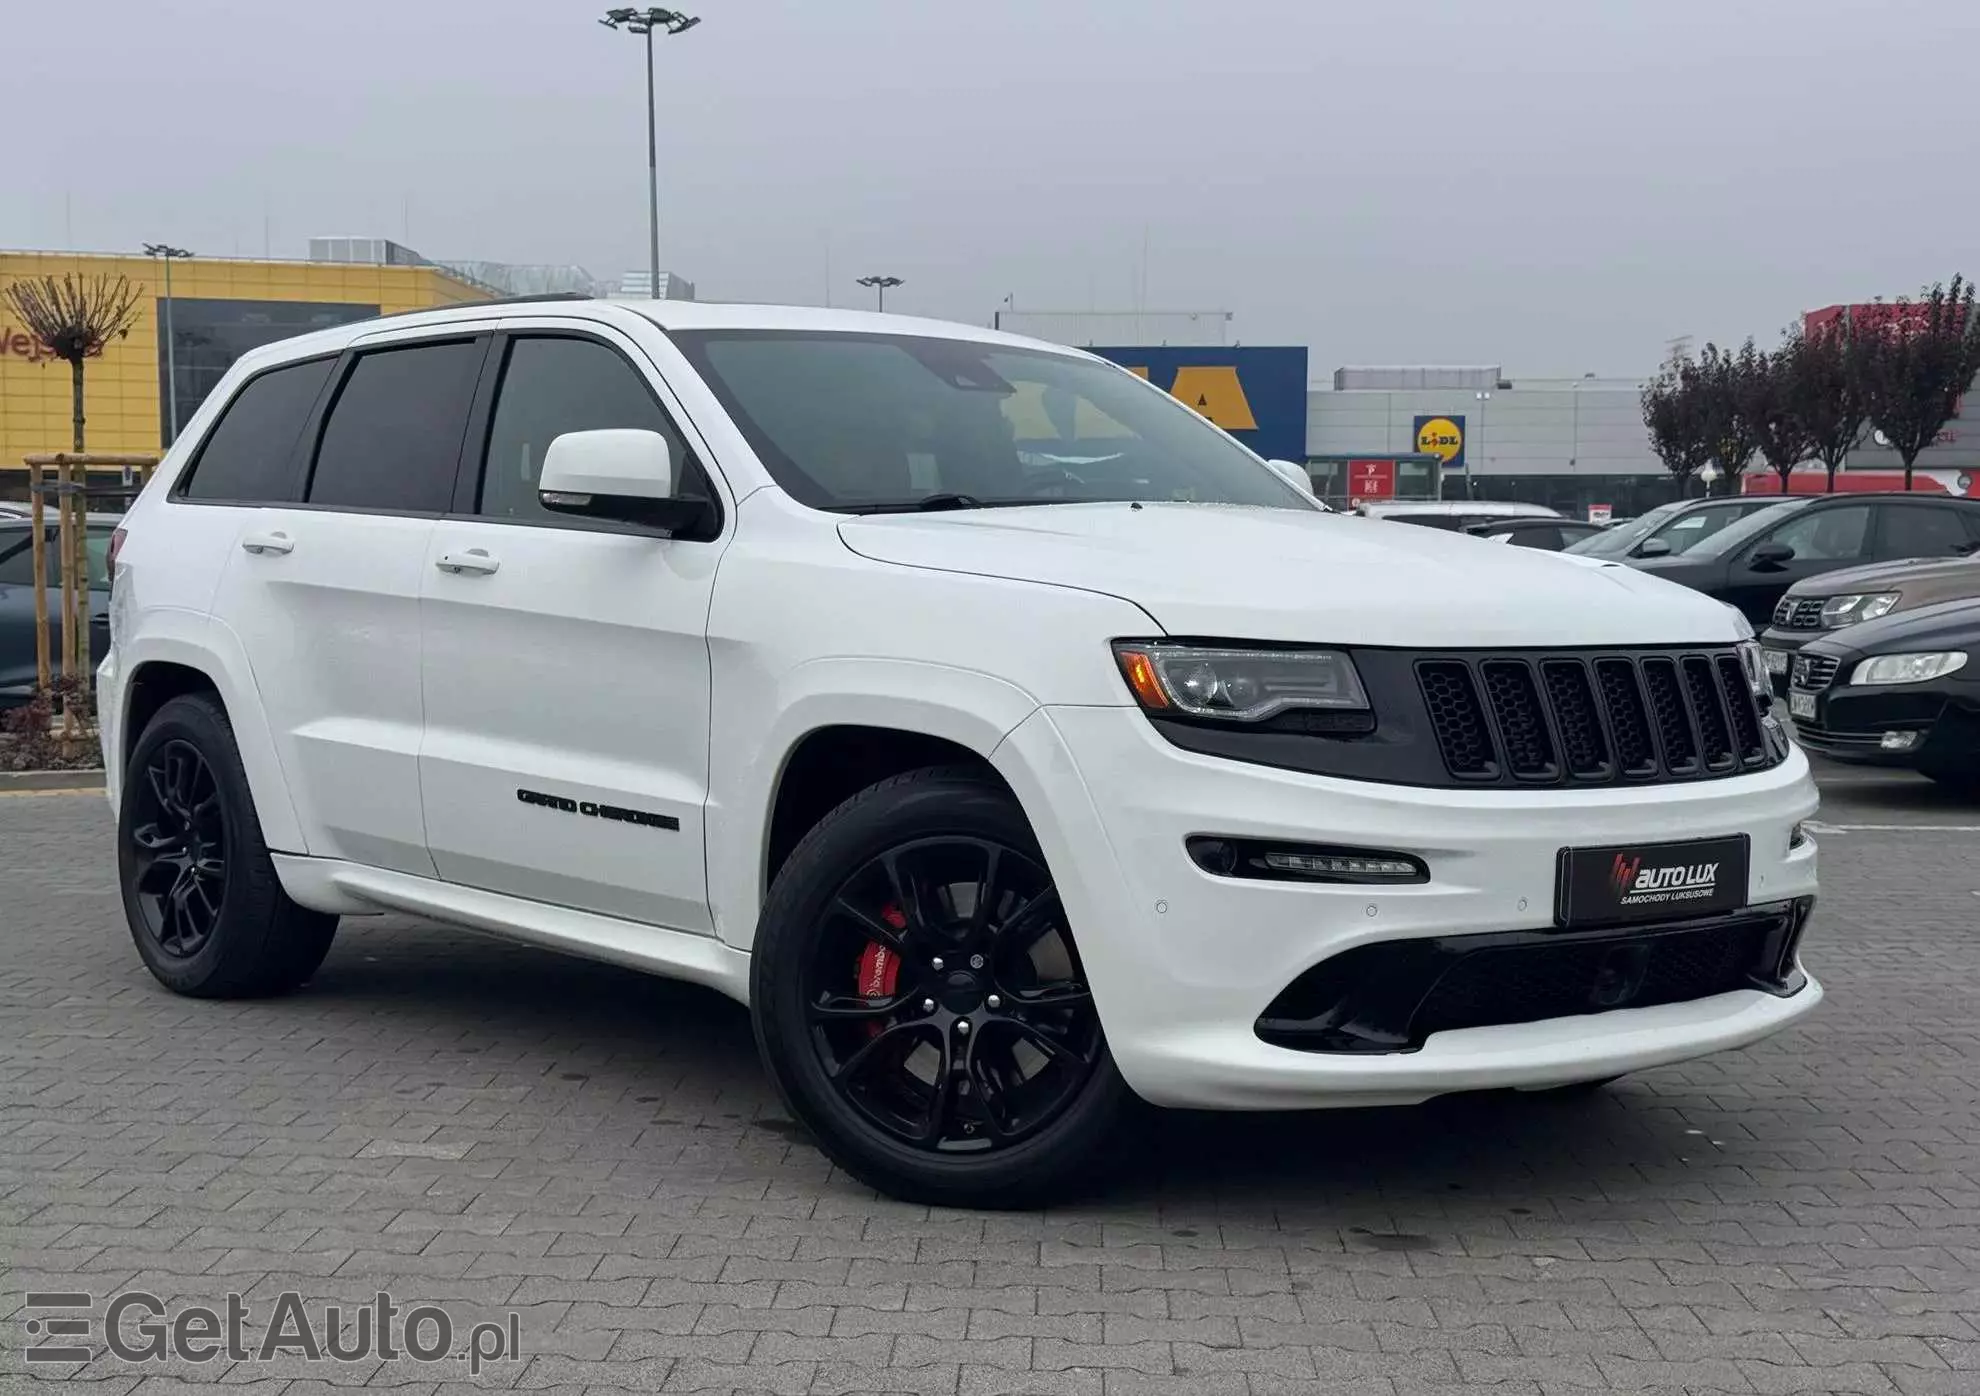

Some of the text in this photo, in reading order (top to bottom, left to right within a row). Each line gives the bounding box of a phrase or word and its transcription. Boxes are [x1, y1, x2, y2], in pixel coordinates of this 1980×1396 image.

[516, 788, 577, 813] GRAND
[1685, 862, 1719, 885] LUX
[1621, 889, 1714, 904] SAMOCHODY LUKSUSOWE
